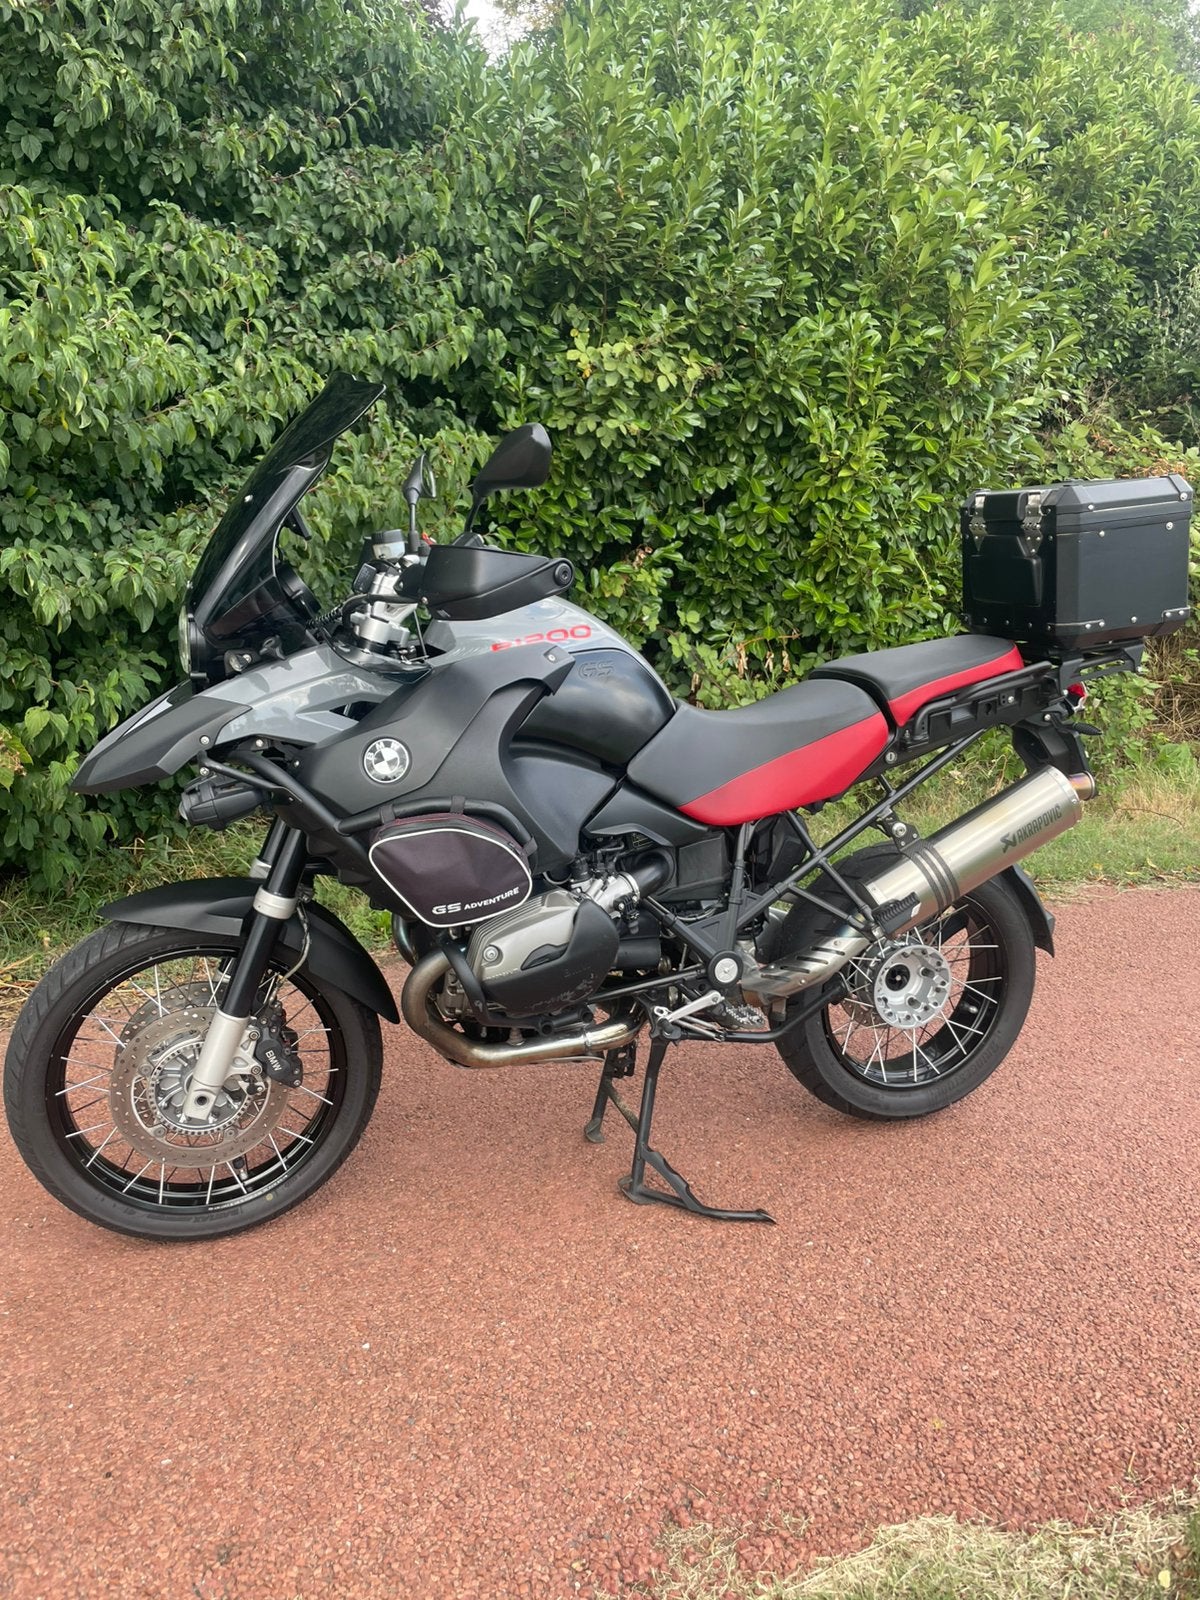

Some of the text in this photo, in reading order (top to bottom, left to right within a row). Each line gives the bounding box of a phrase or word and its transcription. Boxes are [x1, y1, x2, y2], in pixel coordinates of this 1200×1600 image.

[432, 886, 520, 915] GS ADVENTURE
[265, 1049, 282, 1071] BMW
